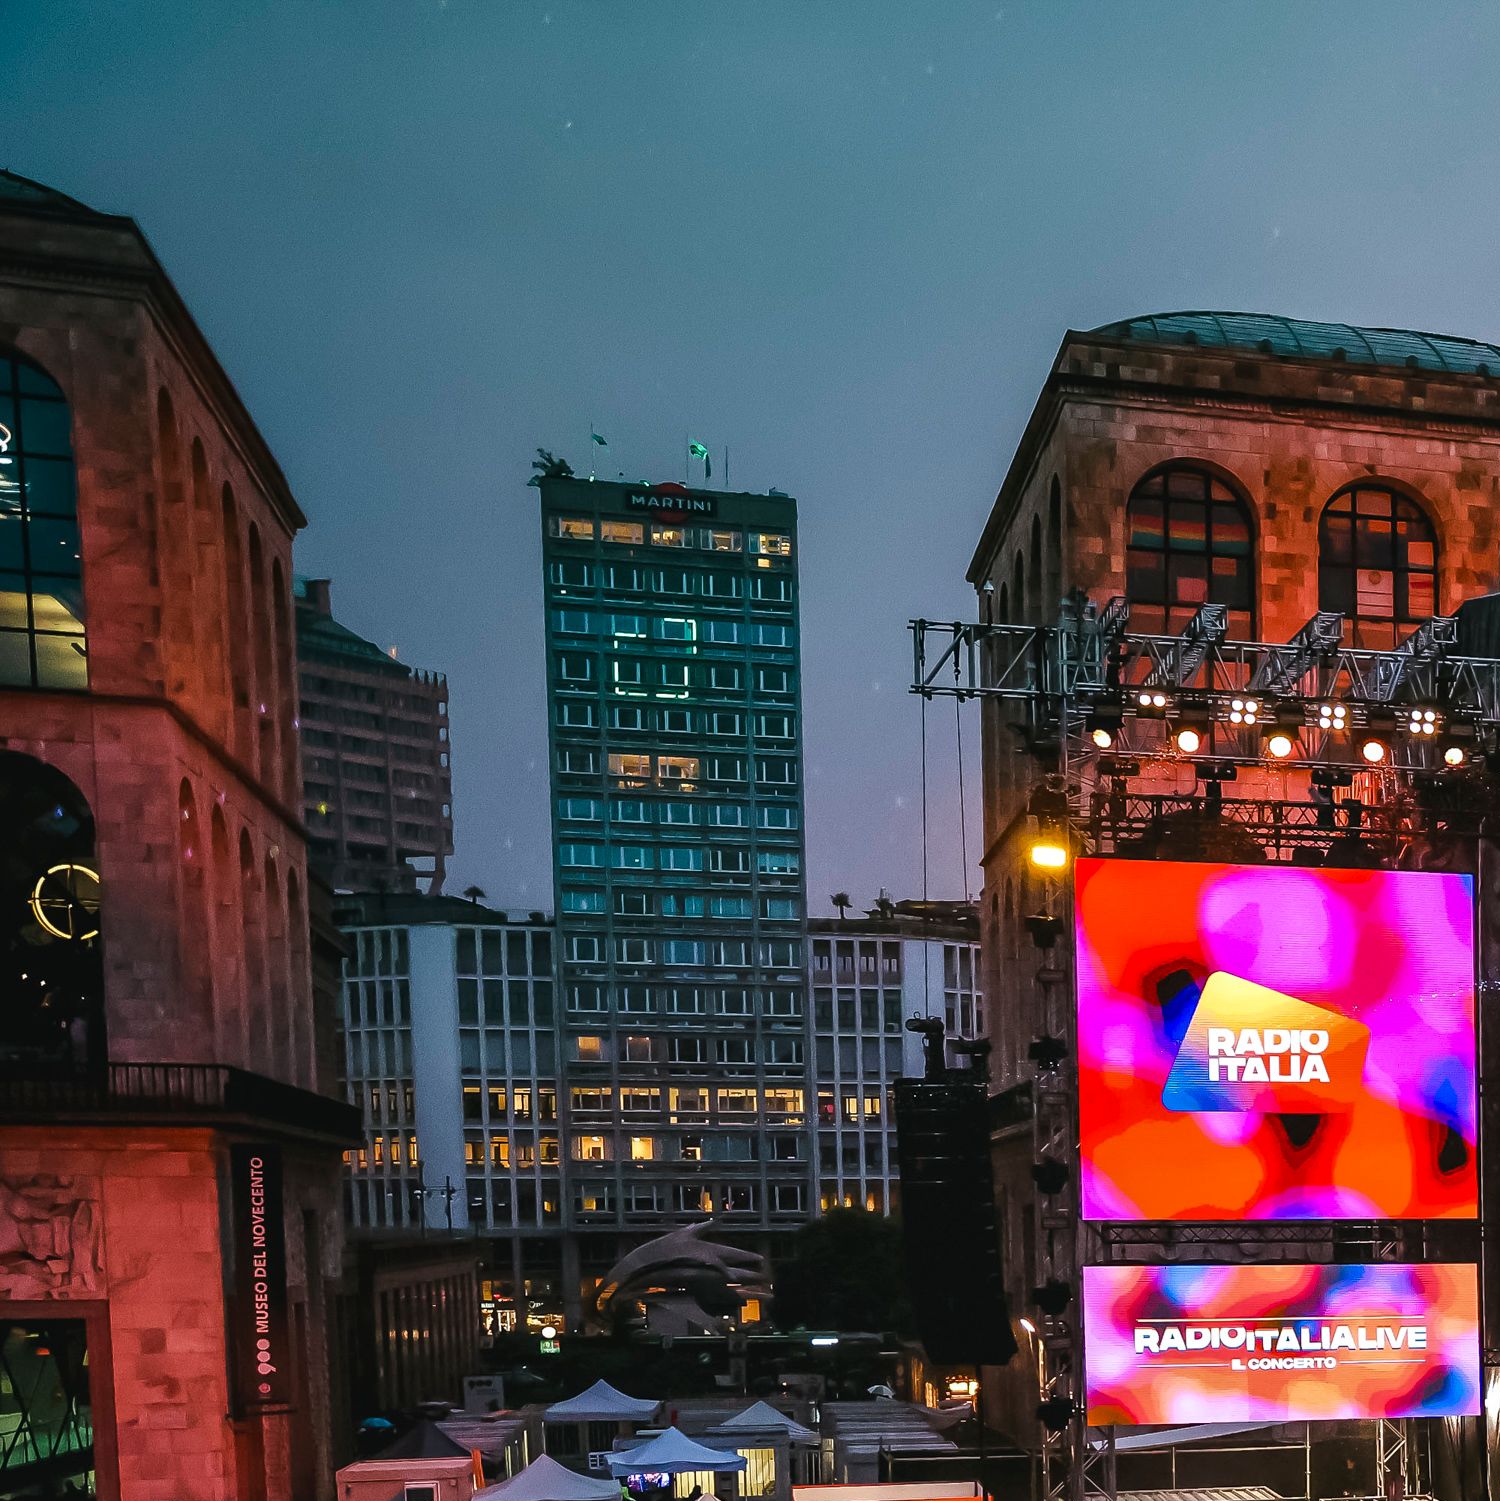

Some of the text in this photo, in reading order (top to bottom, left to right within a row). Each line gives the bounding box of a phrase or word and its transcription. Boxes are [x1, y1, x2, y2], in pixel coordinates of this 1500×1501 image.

[631, 494, 712, 512] MARTINI
[1208, 1027, 1330, 1057] RADIO
[1208, 1054, 1331, 1083] ITALIA
[250, 1157, 267, 1248] NOVECENTO
[253, 1251, 267, 1278] DEL
[255, 1282, 269, 1333] MUSEO
[1231, 1356, 1337, 1371] IL CONCERTO
